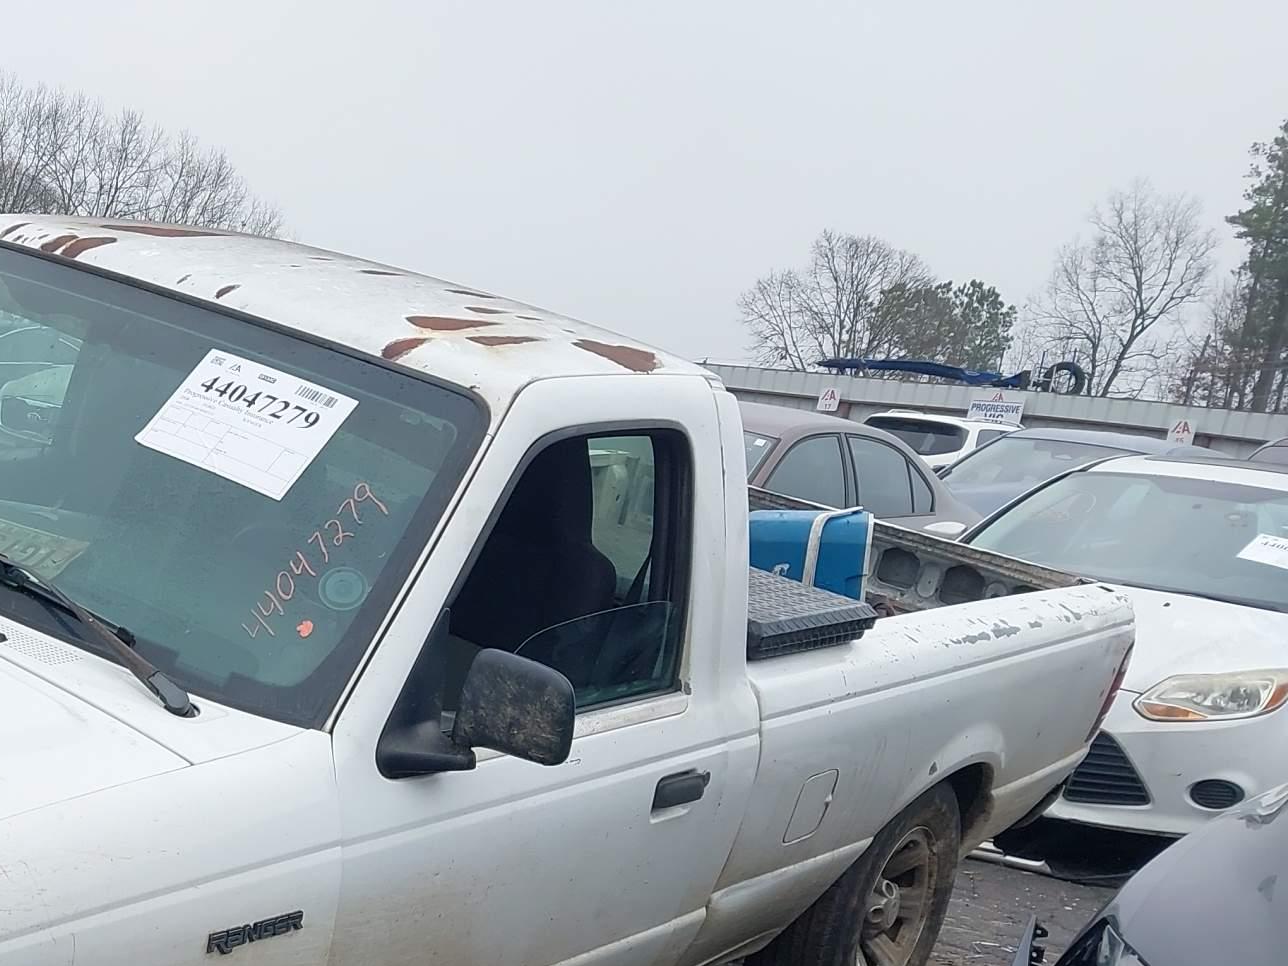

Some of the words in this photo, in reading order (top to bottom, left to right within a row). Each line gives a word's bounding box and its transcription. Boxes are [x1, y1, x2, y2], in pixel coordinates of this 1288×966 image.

[201, 375, 321, 429] 44047279
[970, 402, 1023, 414] PROGRESSIVE
[241, 482, 389, 638] 44047279
[206, 910, 304, 955] RANGER
